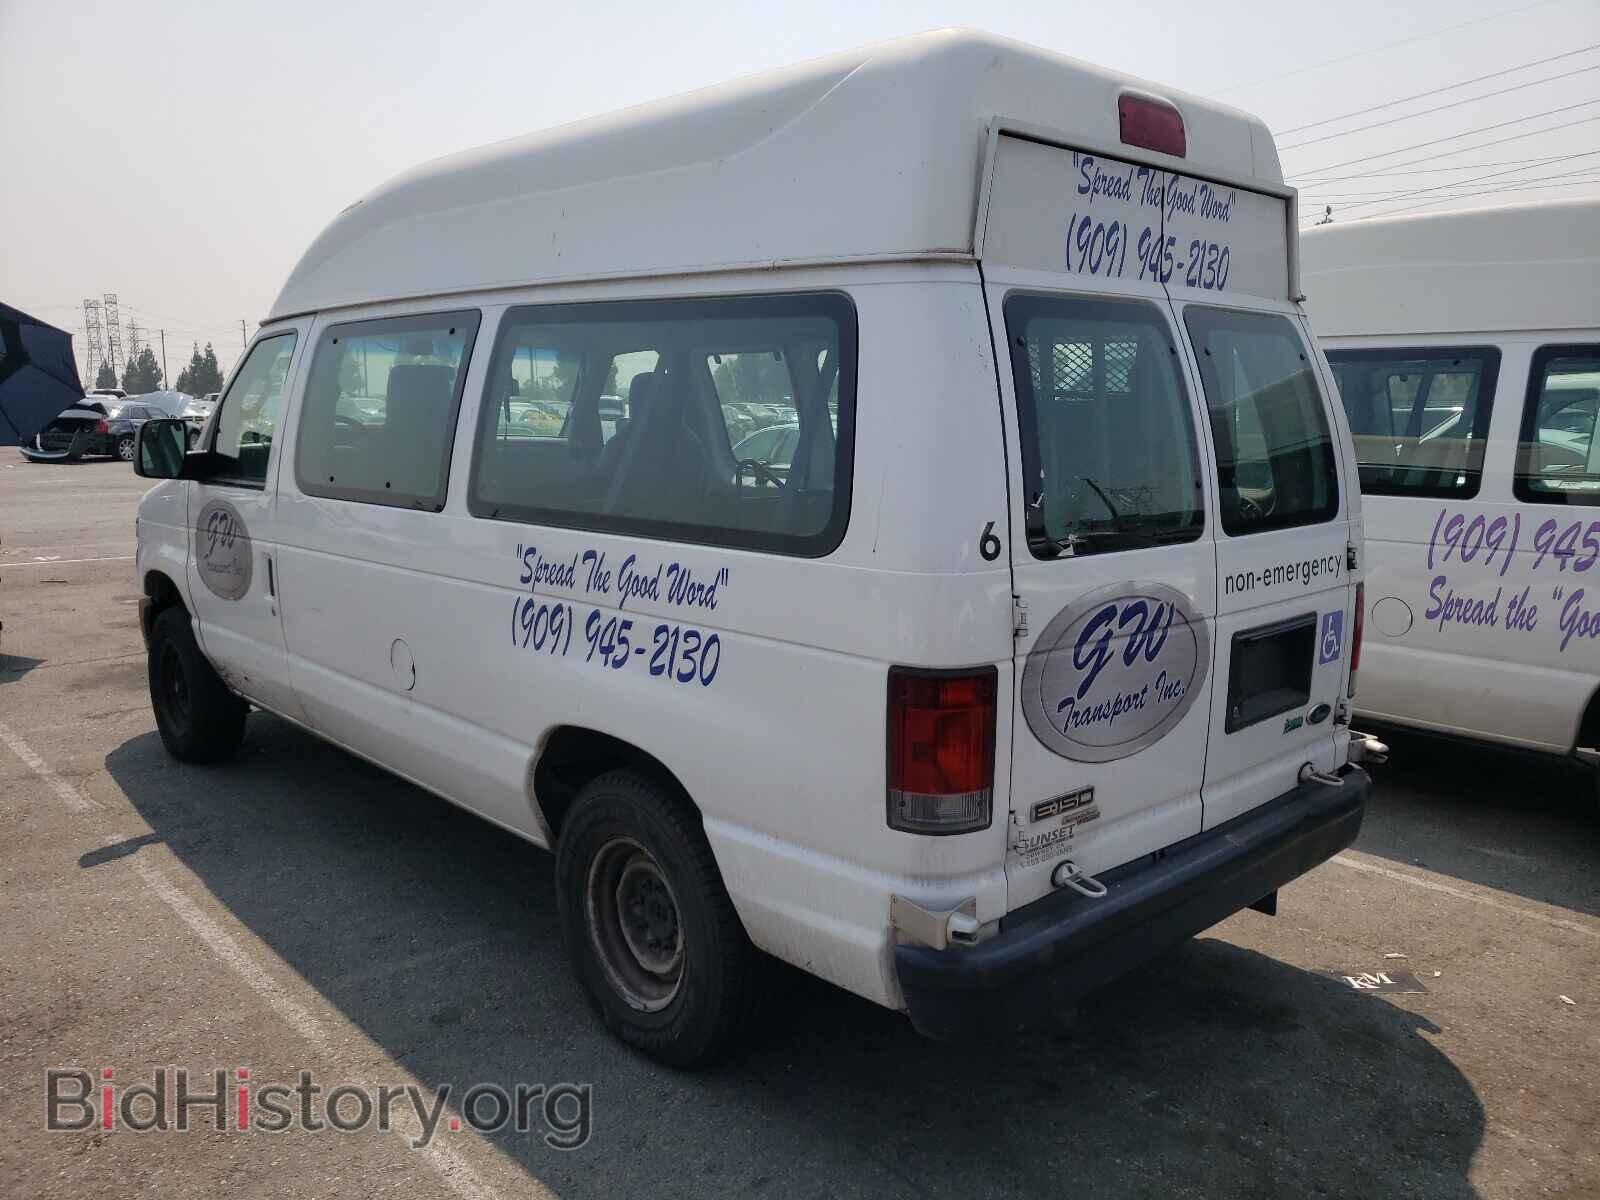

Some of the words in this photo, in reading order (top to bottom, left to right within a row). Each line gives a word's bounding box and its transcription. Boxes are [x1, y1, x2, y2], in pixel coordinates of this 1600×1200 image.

[1073, 151, 1134, 204] "Spread
[1137, 165, 1162, 207] The
[1167, 175, 1198, 222] Good
[1200, 183, 1236, 223] Word"
[1066, 212, 1127, 278] (909)
[1137, 226, 1230, 291] 945-2130
[979, 521, 1002, 562] 6
[1225, 555, 1342, 595] non-emergency
[1427, 508, 1521, 577] (909)
[1532, 518, 1600, 573] 945
[516, 543, 578, 593] "Spread
[582, 549, 611, 593] The
[617, 554, 663, 610] Good
[666, 562, 729, 610] Word"
[1425, 575, 1503, 633] Spread
[1505, 585, 1538, 632] the
[511, 596, 573, 656] (909)
[585, 608, 721, 687] 945-2130
[1072, 599, 1176, 700] GW
[1057, 684, 1149, 734] Transport
[1155, 670, 1186, 704] Inc.
